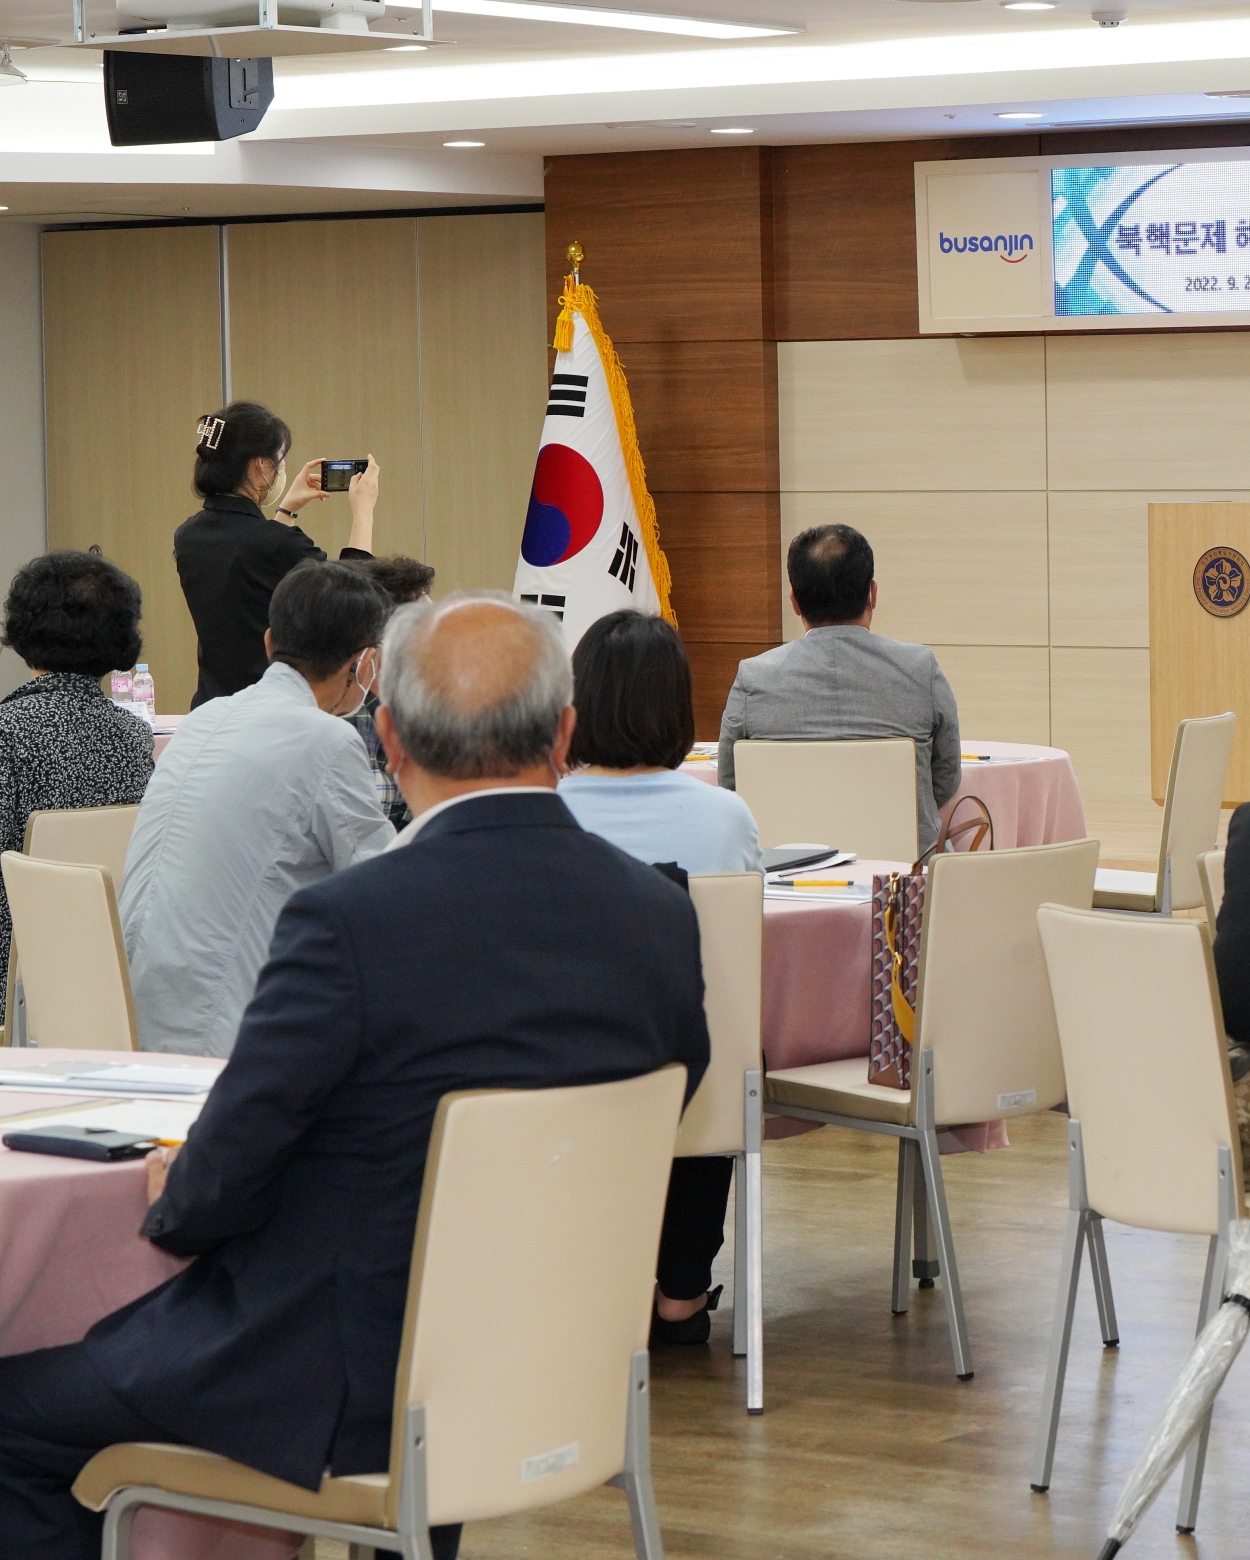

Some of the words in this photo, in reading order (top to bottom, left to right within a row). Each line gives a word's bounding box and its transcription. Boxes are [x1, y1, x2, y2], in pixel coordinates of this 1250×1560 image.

[939, 232, 1034, 257] busanjin
[1115, 219, 1228, 256] 북핵문제
[1185, 275, 1222, 291] 2022.
[1226, 275, 1240, 291] 9.
